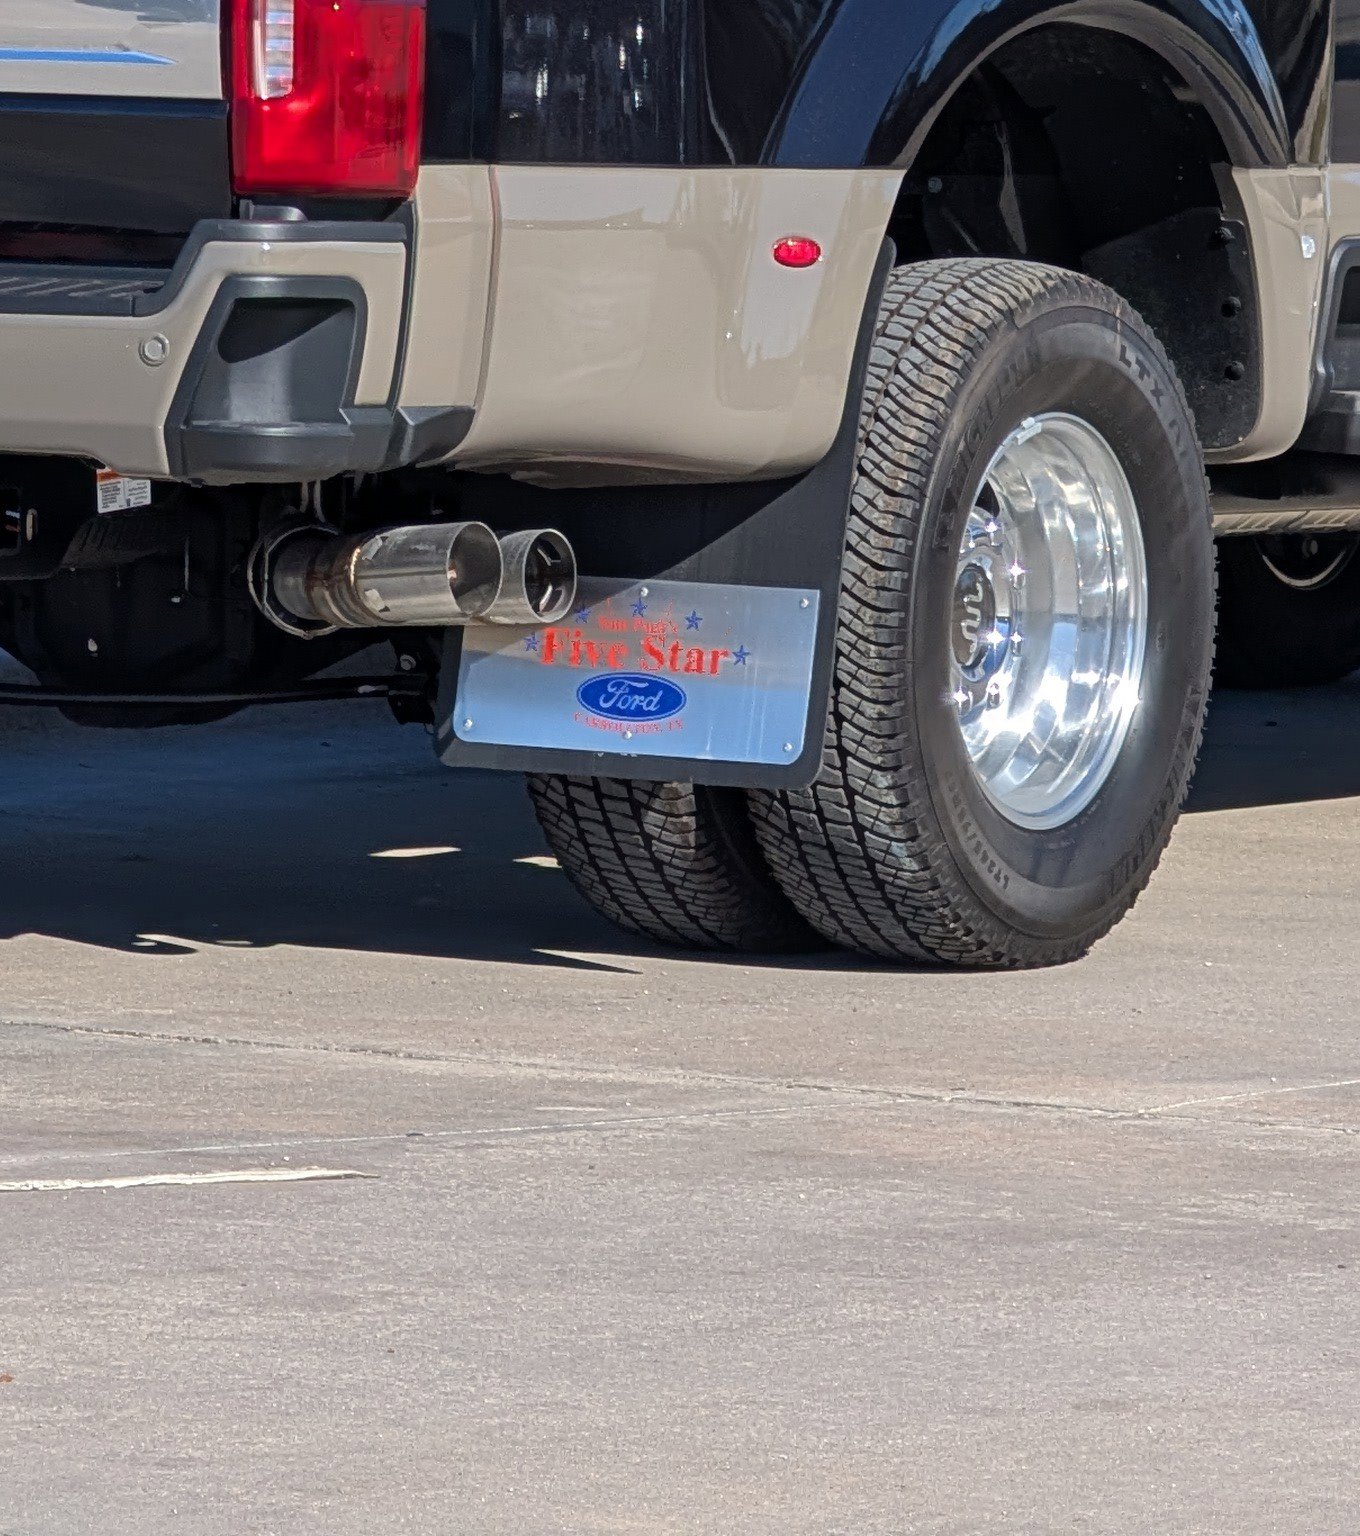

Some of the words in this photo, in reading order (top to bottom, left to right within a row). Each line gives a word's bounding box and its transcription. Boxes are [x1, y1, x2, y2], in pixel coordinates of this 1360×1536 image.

[541, 627, 628, 669] Five
[640, 634, 731, 677] Star
[599, 679, 663, 711] Ford
